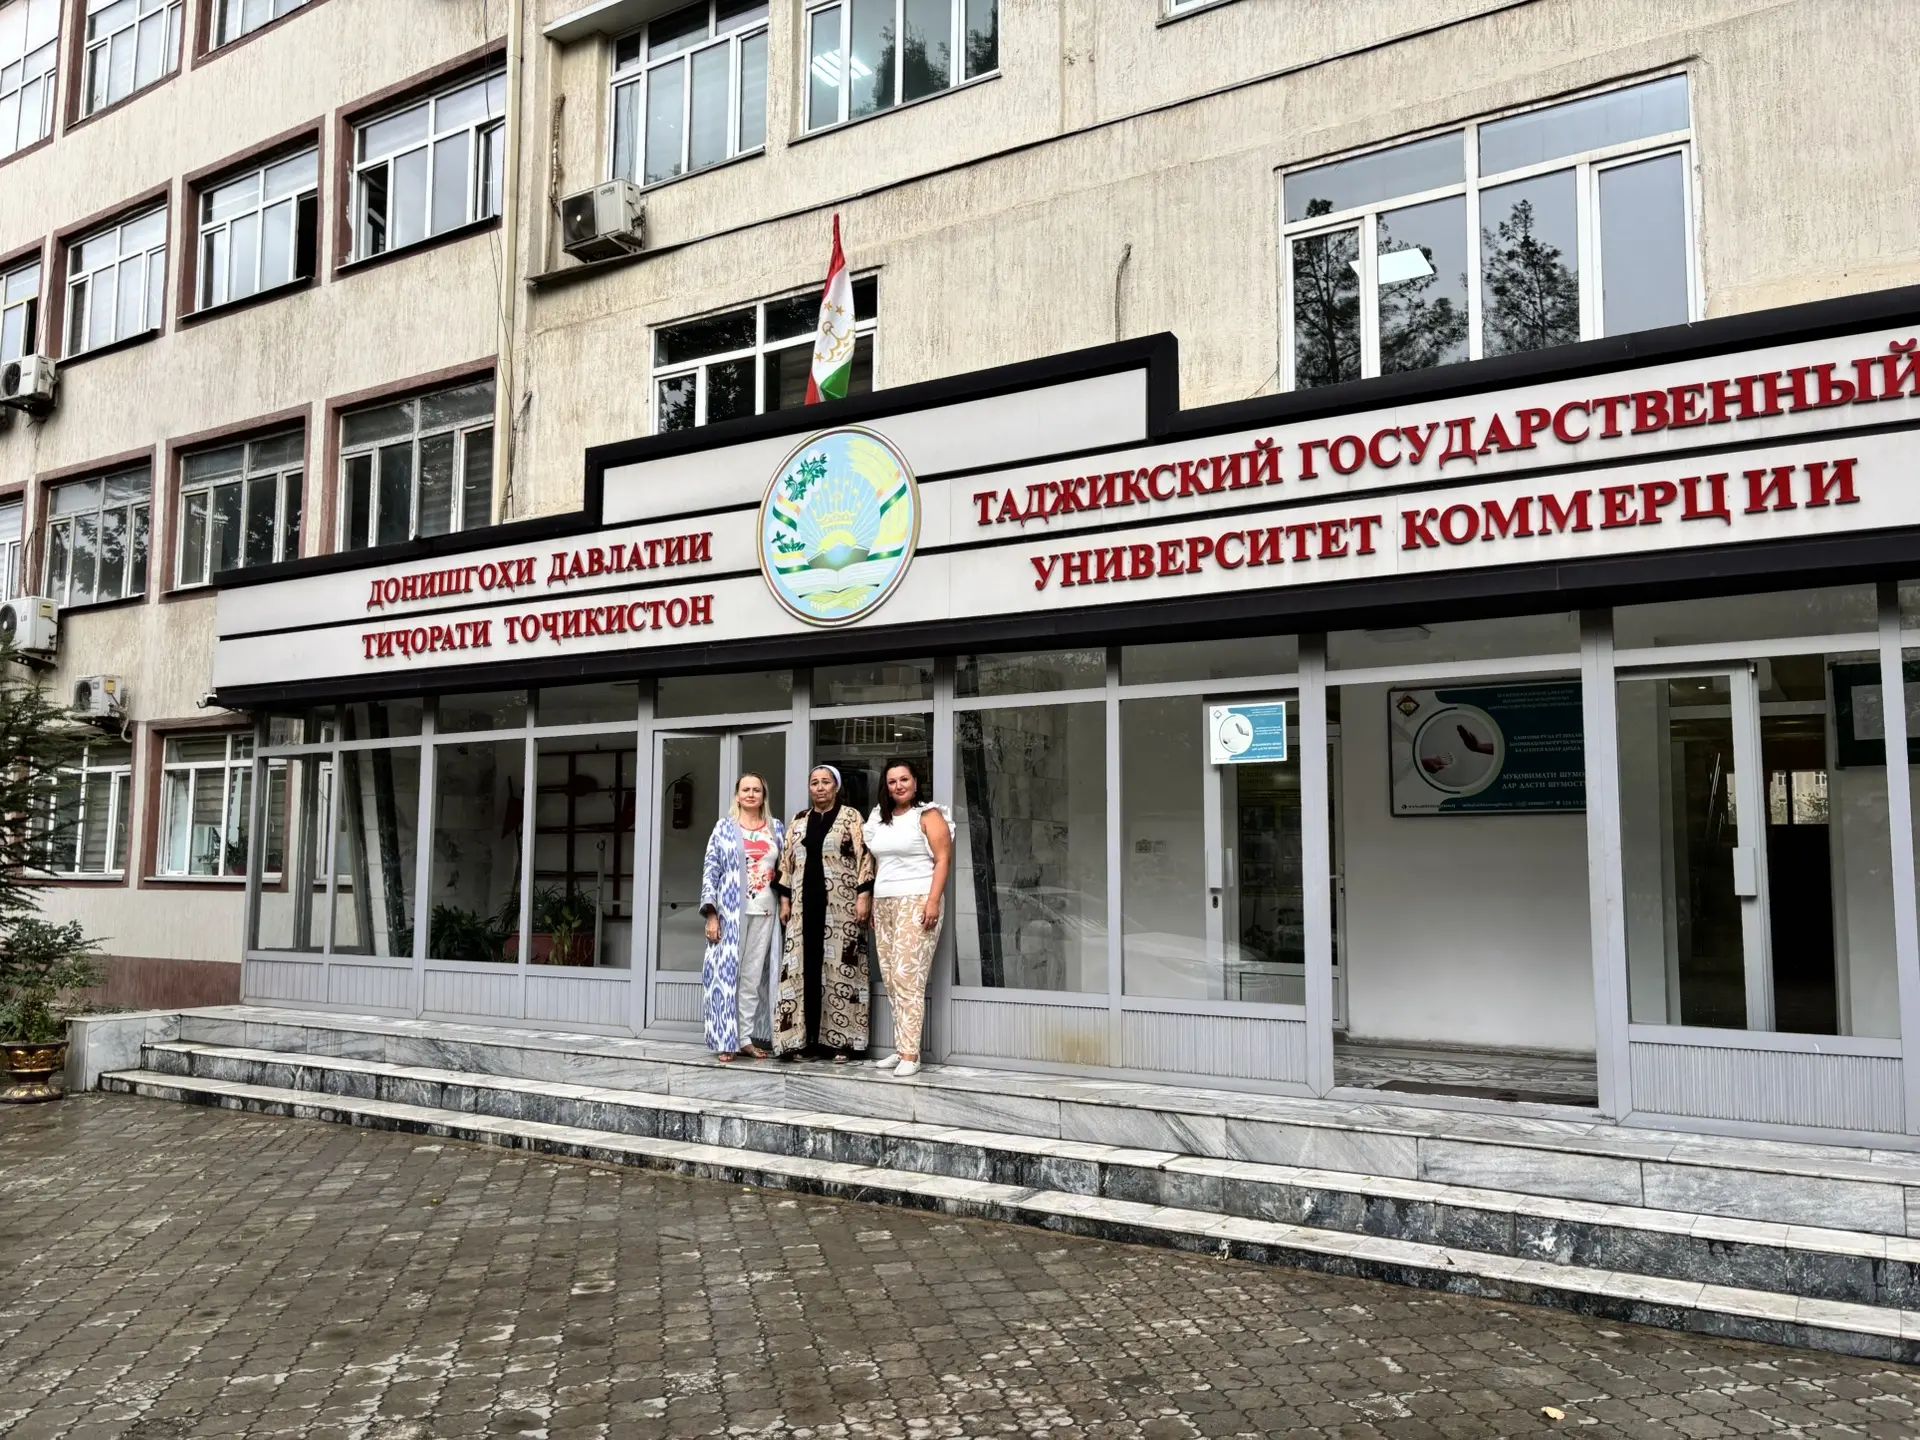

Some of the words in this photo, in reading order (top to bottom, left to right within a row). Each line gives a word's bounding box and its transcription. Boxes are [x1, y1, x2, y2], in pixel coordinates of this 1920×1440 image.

[973, 436, 1284, 527] ТАДЖИКСКИЙ
[1298, 337, 1920, 480] ГОСУДАРСТВЕННЫЙ
[366, 556, 537, 611] ДОНИШГОҲИ
[547, 531, 713, 587] ДАВЛАТИИ
[1030, 514, 1383, 591] УНИВЕРСИТЕТ
[1401, 457, 1860, 550] КОММЕРЦИИ
[362, 619, 493, 660] ТИҶОРАТИ
[504, 594, 714, 646] ТОҶИКИСТОН
